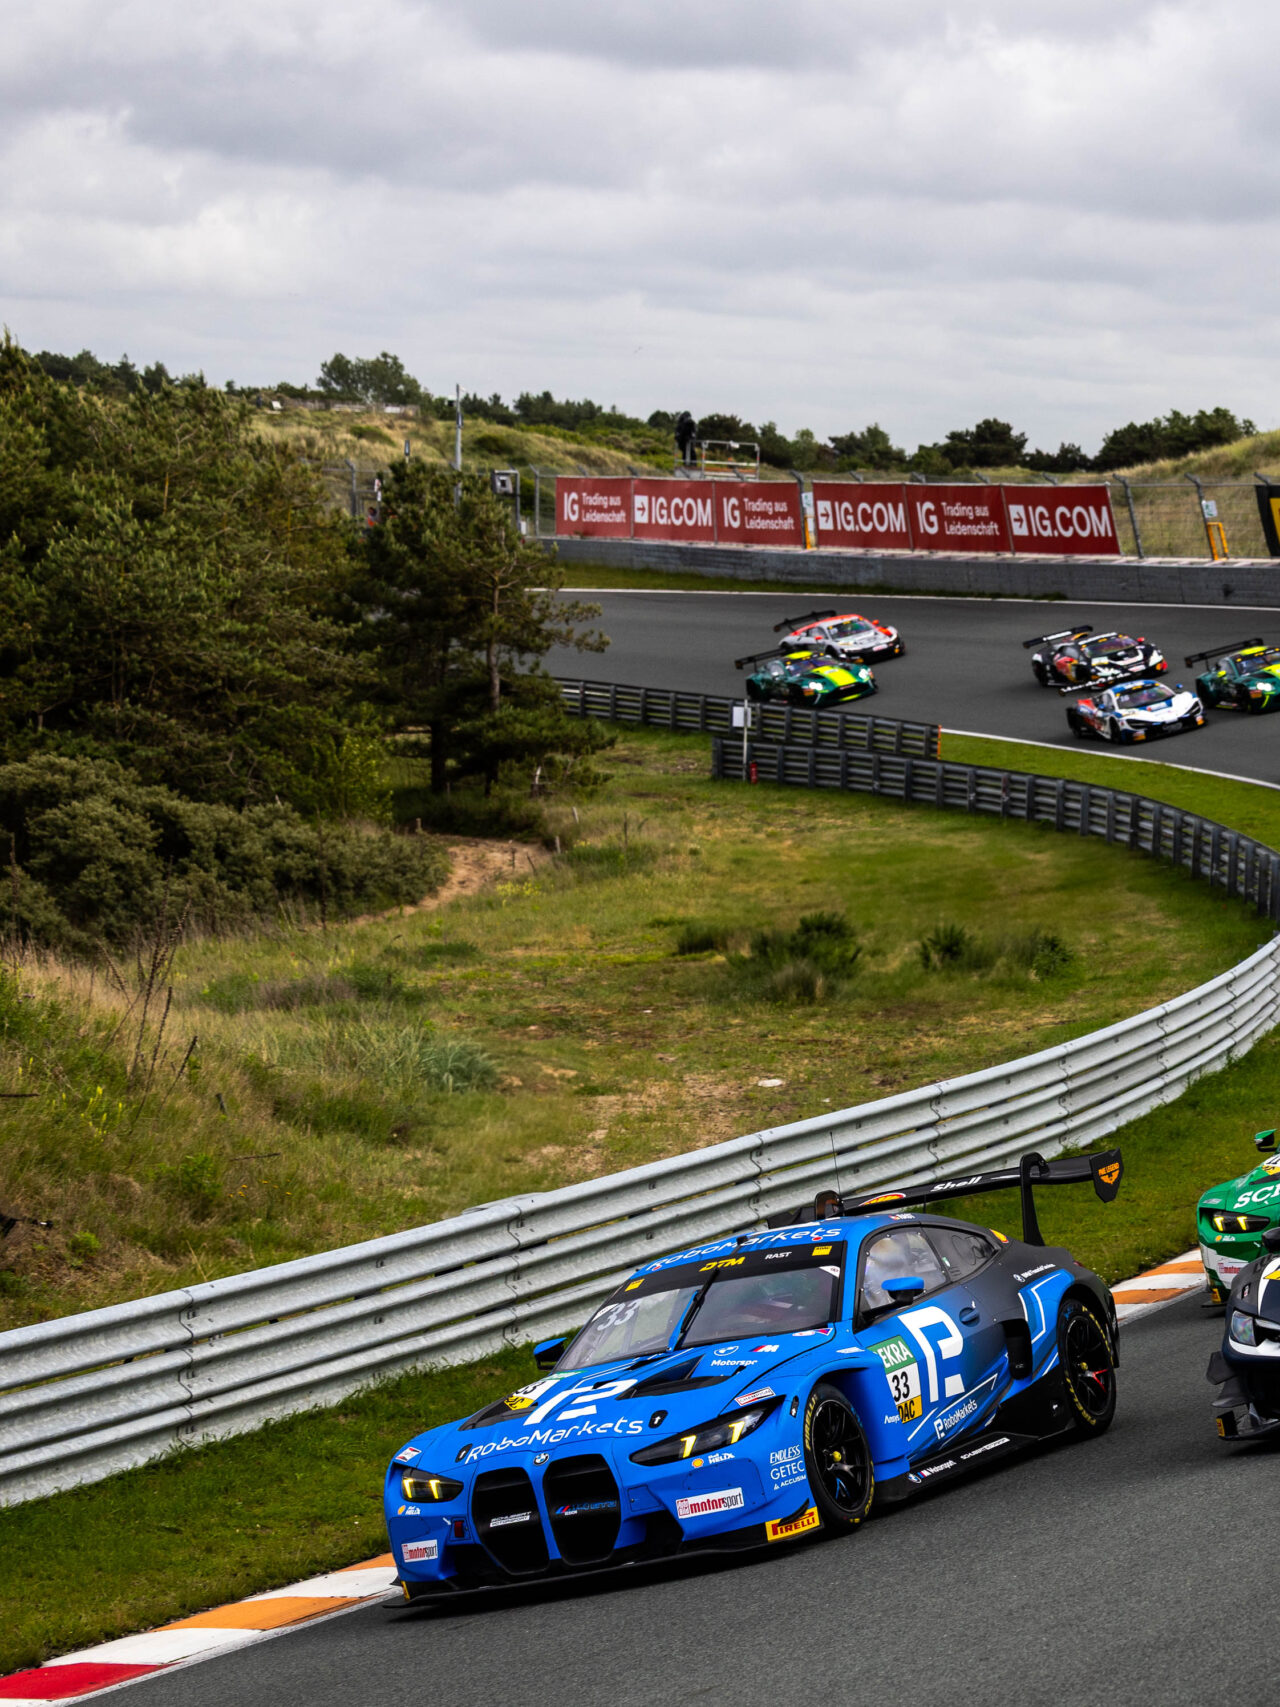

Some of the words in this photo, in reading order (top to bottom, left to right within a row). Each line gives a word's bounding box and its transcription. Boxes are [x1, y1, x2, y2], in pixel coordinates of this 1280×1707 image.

[563, 492, 579, 522] IG
[582, 493, 608, 507] Trading
[609, 495, 622, 507] aus
[744, 498, 773, 514] Trading
[774, 501, 788, 512] aus
[941, 501, 973, 519] Trading
[974, 504, 989, 517] aus
[581, 508, 627, 523] Leidenschaft
[651, 497, 713, 528] IG.COM
[722, 497, 741, 528] IG
[744, 515, 795, 531] Leidenschaft
[834, 501, 907, 533] IG.COM
[916, 501, 939, 535] IG
[1028, 505, 1113, 538] IG.COM
[944, 520, 1000, 537] Leidenschaft
[930, 1176, 983, 1192] Shell
[645, 1227, 843, 1271] RoboMarkets
[764, 1251, 793, 1260] RAST
[698, 1256, 746, 1273] DTM
[597, 1302, 639, 1331] 33
[873, 1340, 914, 1369] EKRA
[891, 1370, 911, 1403] 33
[897, 1400, 916, 1424] DAC
[943, 1398, 978, 1430] RoboMarkets
[464, 1416, 644, 1465] RoboMarkets
[769, 1444, 801, 1464] ENDLESS
[770, 1460, 805, 1481] GETEC
[780, 1475, 807, 1488] ACCUSIM
[690, 1492, 743, 1514] motorsport
[771, 1511, 816, 1537] PIRELLI
